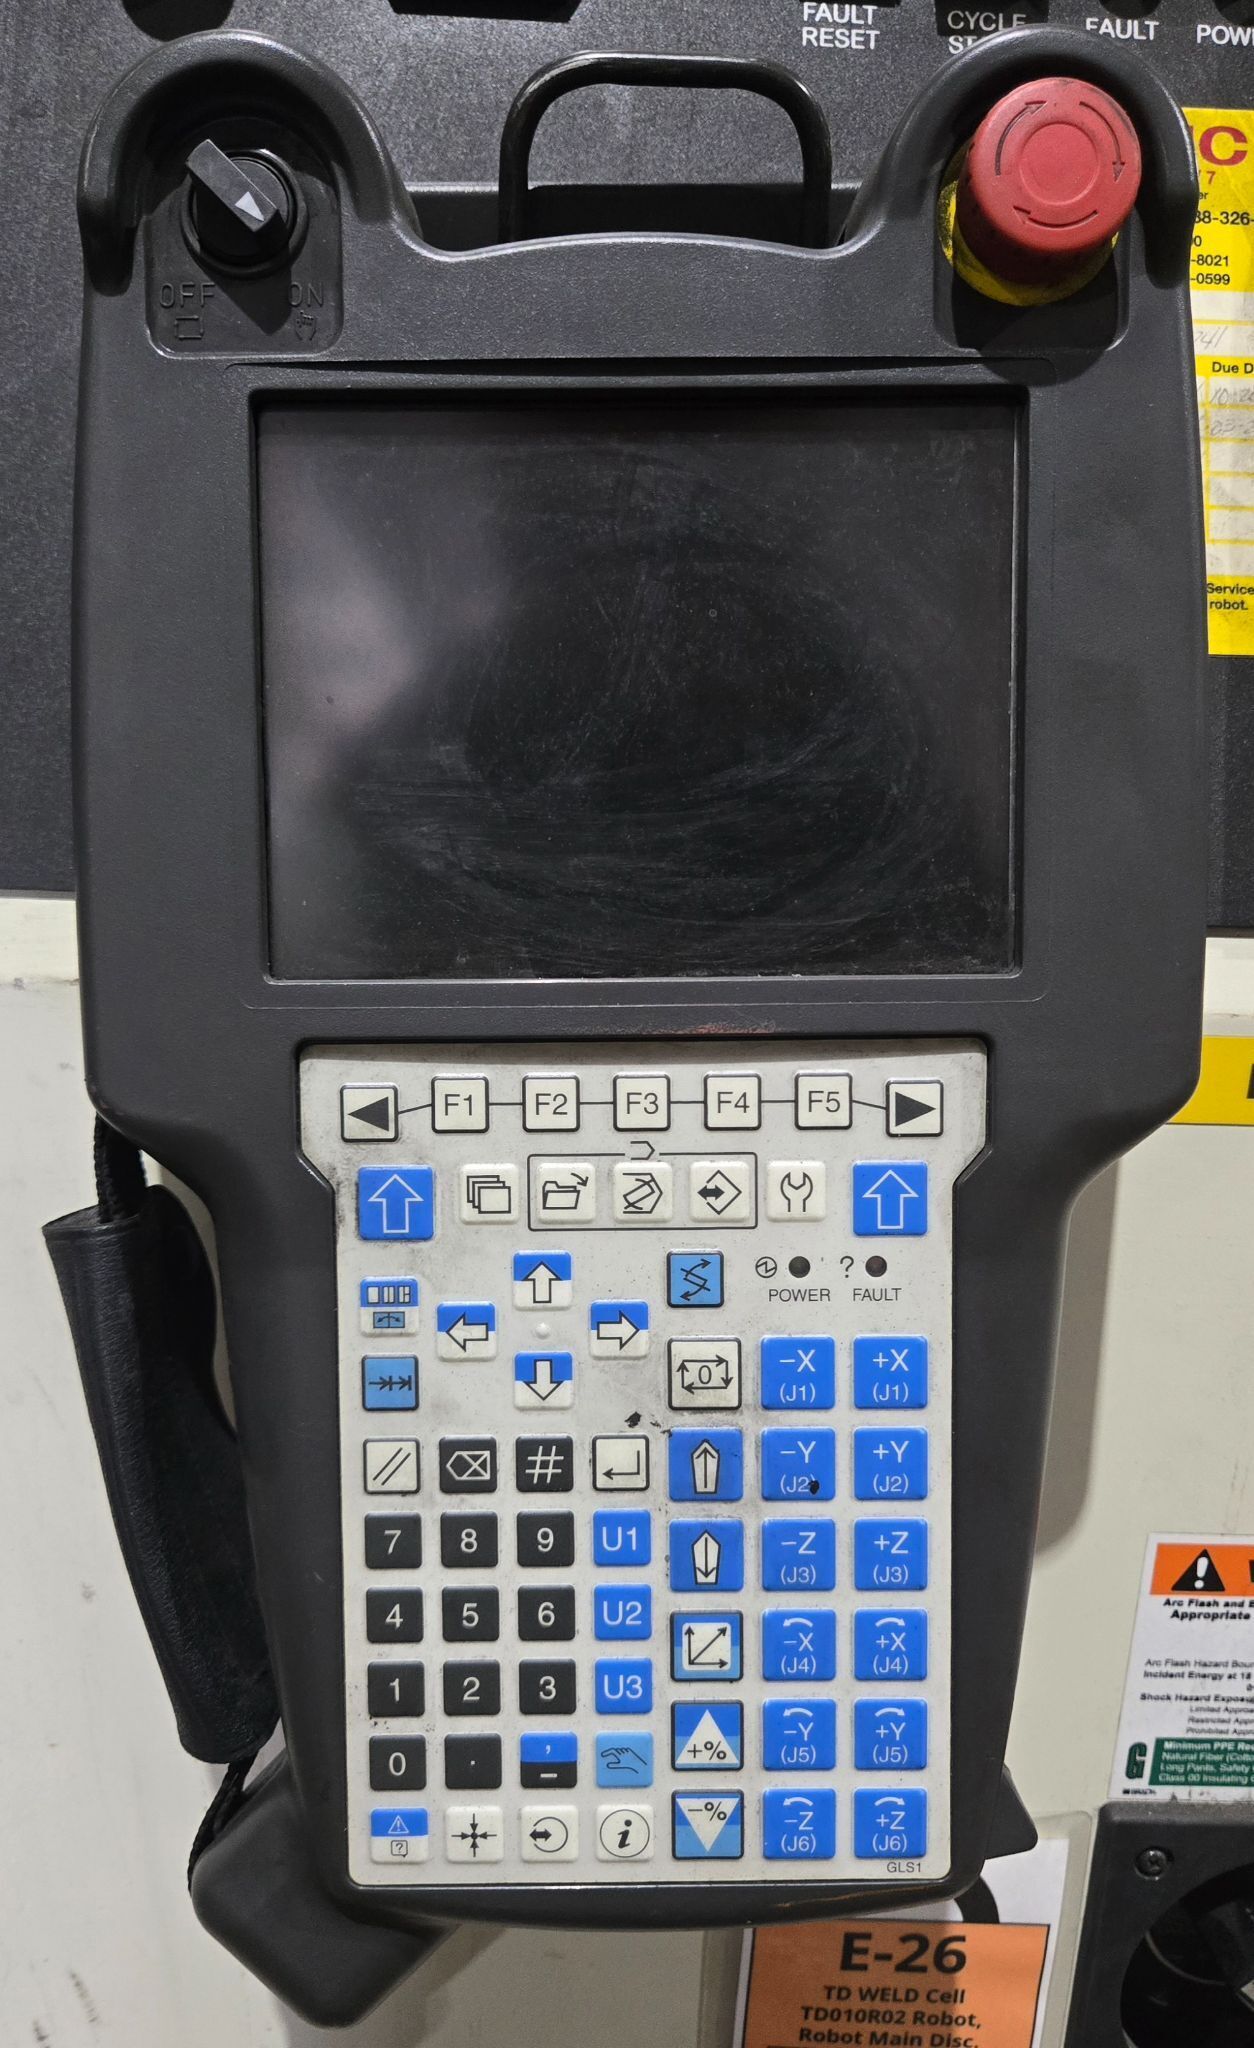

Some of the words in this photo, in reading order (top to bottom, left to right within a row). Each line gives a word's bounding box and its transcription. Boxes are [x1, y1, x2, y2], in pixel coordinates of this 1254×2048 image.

[803, 2, 878, 25] FAULT
[802, 26, 880, 50] RESET
[1086, 18, 1160, 40] FAULT
[1196, 24, 1254, 46] POW
[160, 282, 216, 308] OFF
[288, 281, 325, 307] ON
[1212, 361, 1240, 374] Due
[1244, 363, 1254, 374] D
[1206, 583, 1254, 595] Service
[1210, 599, 1248, 611] robot.
[444, 1093, 473, 1116] F1
[535, 1093, 568, 1116] F2
[626, 1092, 659, 1115] F3
[717, 1091, 750, 1114] F4
[808, 1090, 841, 1113] F5
[768, 1288, 831, 1302] POWER
[853, 1287, 902, 1302] FAULT
[779, 1349, 816, 1372] -X
[872, 1349, 909, 1372] +X
[779, 1383, 816, 1403] (J1)
[872, 1382, 909, 1403] (J1)
[780, 1441, 816, 1464] -Y
[873, 1441, 909, 1463] +Y
[873, 1473, 909, 1493] (J2)
[384, 1529, 401, 1554] 7
[460, 1528, 478, 1552] 8
[536, 1527, 554, 1552] 9
[602, 1526, 637, 1551] U1
[781, 1531, 816, 1554] -Z
[874, 1531, 909, 1554] +Z
[780, 1565, 817, 1585] (J3)
[873, 1564, 909, 1584] (J3)
[603, 1600, 642, 1625] U2
[1163, 1598, 1183, 1607] Arc
[1188, 1599, 1219, 1608] Flash
[1223, 1599, 1244, 1608] and
[385, 1603, 403, 1629] 4
[462, 1603, 479, 1628] 5
[538, 1602, 556, 1627] 6
[1170, 1609, 1250, 1621] Appropriate
[784, 1632, 814, 1651] -X
[876, 1632, 906, 1651] +X
[781, 1655, 817, 1675] (J4)
[873, 1655, 909, 1675] (J4)
[1145, 1659, 1162, 1667] Arc
[1144, 1670, 1185, 1679] Incident
[1188, 1671, 1224, 1681] Energy
[390, 1678, 400, 1702] 1
[462, 1676, 480, 1701] 2
[539, 1675, 556, 1700] 3
[604, 1675, 643, 1699] U3
[1140, 1693, 1171, 1701] Shock
[1175, 1693, 1211, 1702] Hazard
[784, 1722, 814, 1741] -Y
[876, 1722, 906, 1741] +Y
[687, 1740, 727, 1760] +%
[781, 1745, 817, 1765] (J5)
[873, 1745, 908, 1765] (J5)
[388, 1752, 406, 1776] 0
[784, 1811, 814, 1830] -Z
[876, 1811, 905, 1830] +Z
[781, 1834, 817, 1853] (J6)
[872, 1833, 908, 1853] (J6)
[886, 1861, 922, 1873] GLS1
[840, 1932, 967, 1974] E-26
[824, 1985, 852, 2001] TD
[859, 1986, 919, 2003] WELD
[926, 1987, 966, 2004] Cell
[801, 2006, 905, 2025] TD010R02
[912, 2009, 981, 2029] Robot,
[799, 2027, 864, 2045] Robot
[869, 2031, 923, 2047] Main
